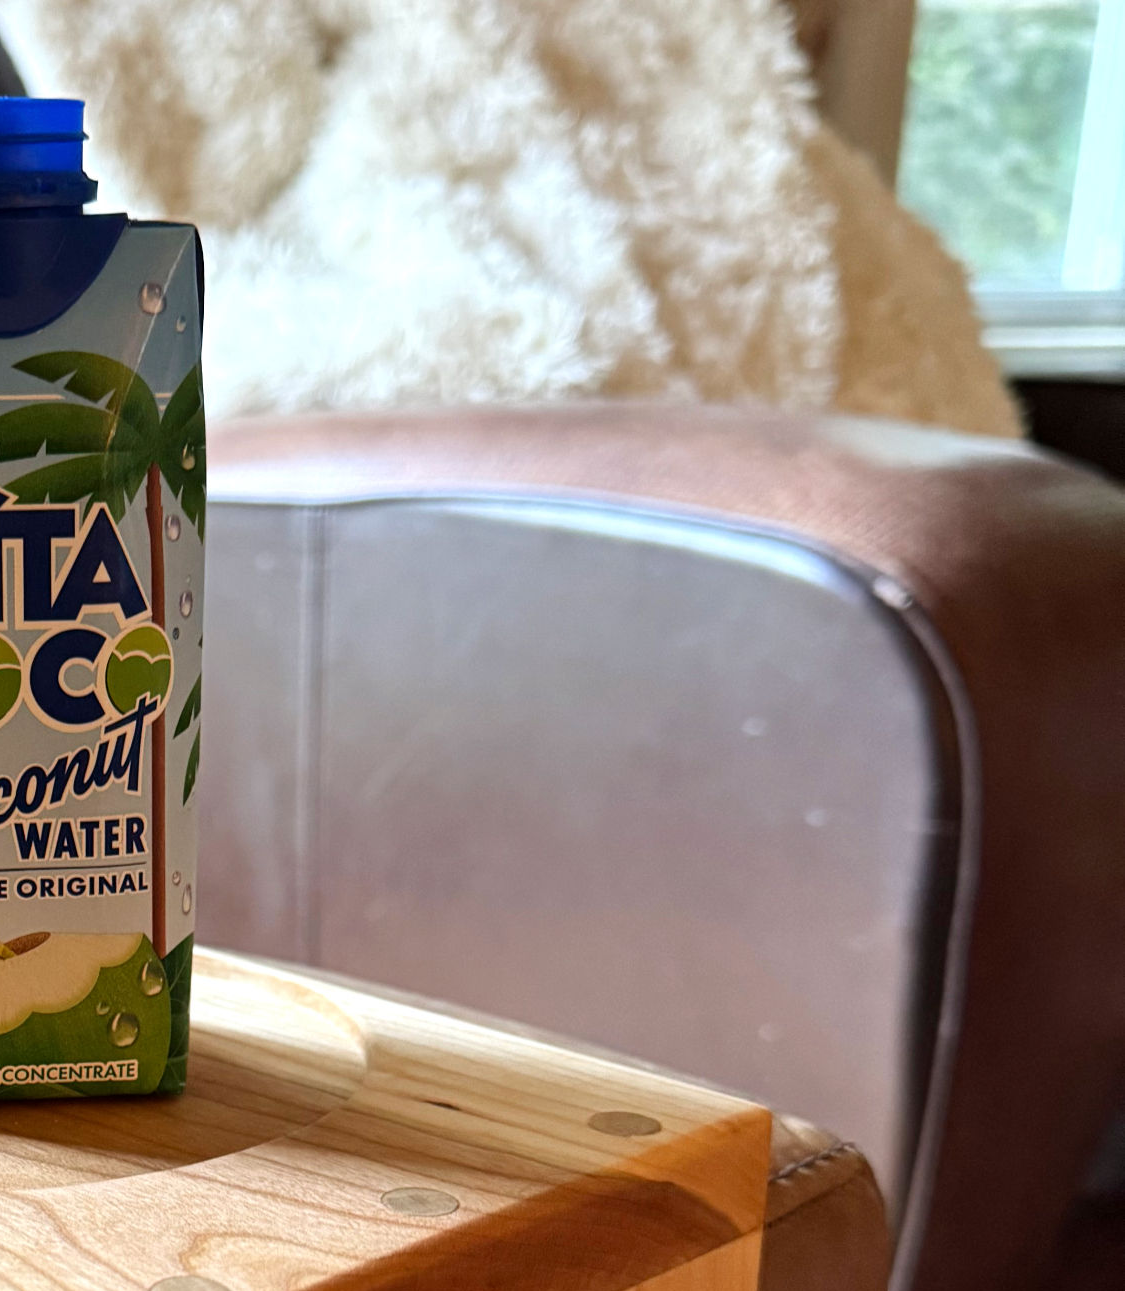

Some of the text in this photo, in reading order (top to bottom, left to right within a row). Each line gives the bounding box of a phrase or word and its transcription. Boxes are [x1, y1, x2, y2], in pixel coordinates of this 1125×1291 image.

[15, 817, 146, 861] WATER
[16, 872, 149, 898] ORIGINAL
[3, 1063, 137, 1083] CONCENTRATE
